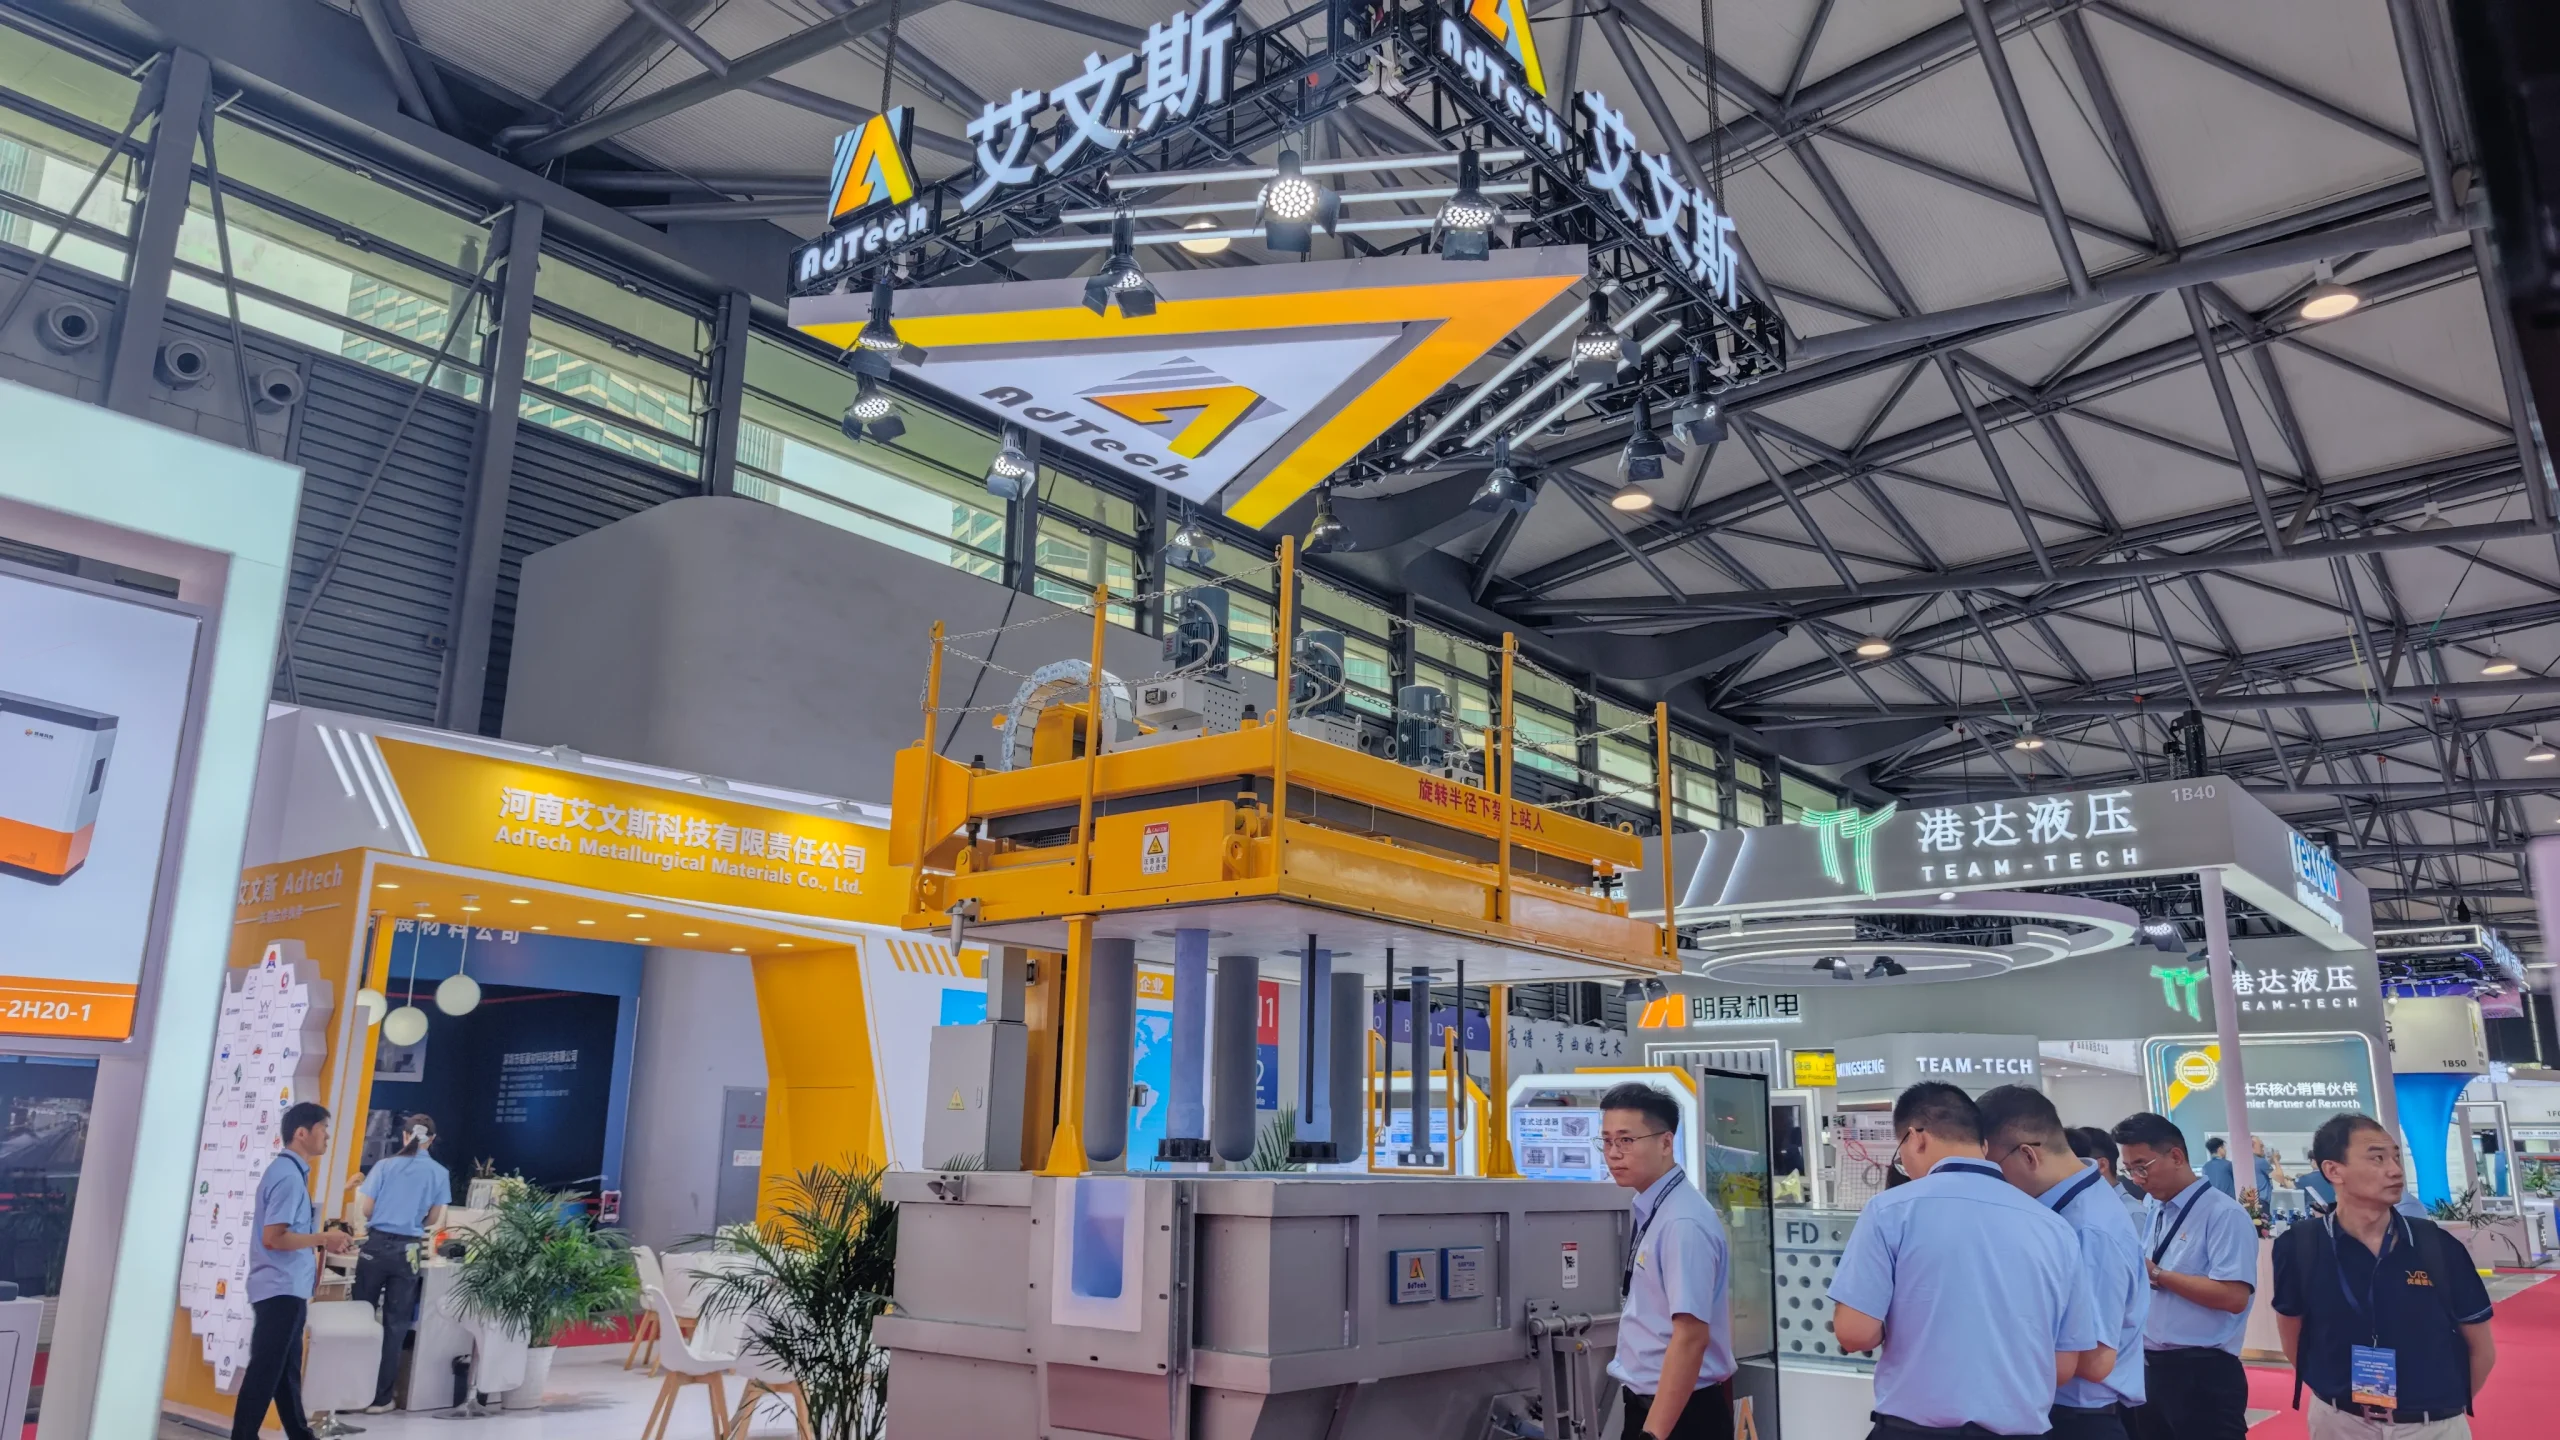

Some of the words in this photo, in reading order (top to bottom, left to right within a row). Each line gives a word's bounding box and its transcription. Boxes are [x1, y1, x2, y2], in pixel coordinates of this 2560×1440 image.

[1441, 19, 1562, 154] AdTech
[960, 2, 1235, 213] 艾文斯
[1584, 90, 1739, 311] 艾文斯
[799, 203, 929, 284] AdTech
[979, 385, 1190, 483] AdTech
[2171, 785, 2216, 803] 1B40
[498, 786, 867, 874] 河南艾文斯科技有限责任公司
[1916, 789, 2138, 853] 港达液压
[494, 825, 572, 852] AdTech
[579, 837, 706, 872] Metallurgical
[711, 857, 793, 885] Materials
[797, 871, 828, 892] Co.,
[834, 876, 863, 895] Ltd.
[1921, 847, 2139, 882] TEAM-TECH
[282, 862, 343, 895] Adtech
[1139, 975, 1164, 995] 企业
[1692, 993, 1800, 1020] 明晟机电
[2242, 997, 2359, 1012] EAM-TECH
[1836, 1058, 1885, 1078] MINGSHENG
[1916, 1056, 2033, 1074] TEAM-TECH
[2442, 1059, 2467, 1068] 1B50
[2267, 1099, 2304, 1109] Partner
[2306, 1098, 2317, 1108] of
[2318, 1098, 2361, 1109] Rexroth
[1786, 1221, 1819, 1244] FD
